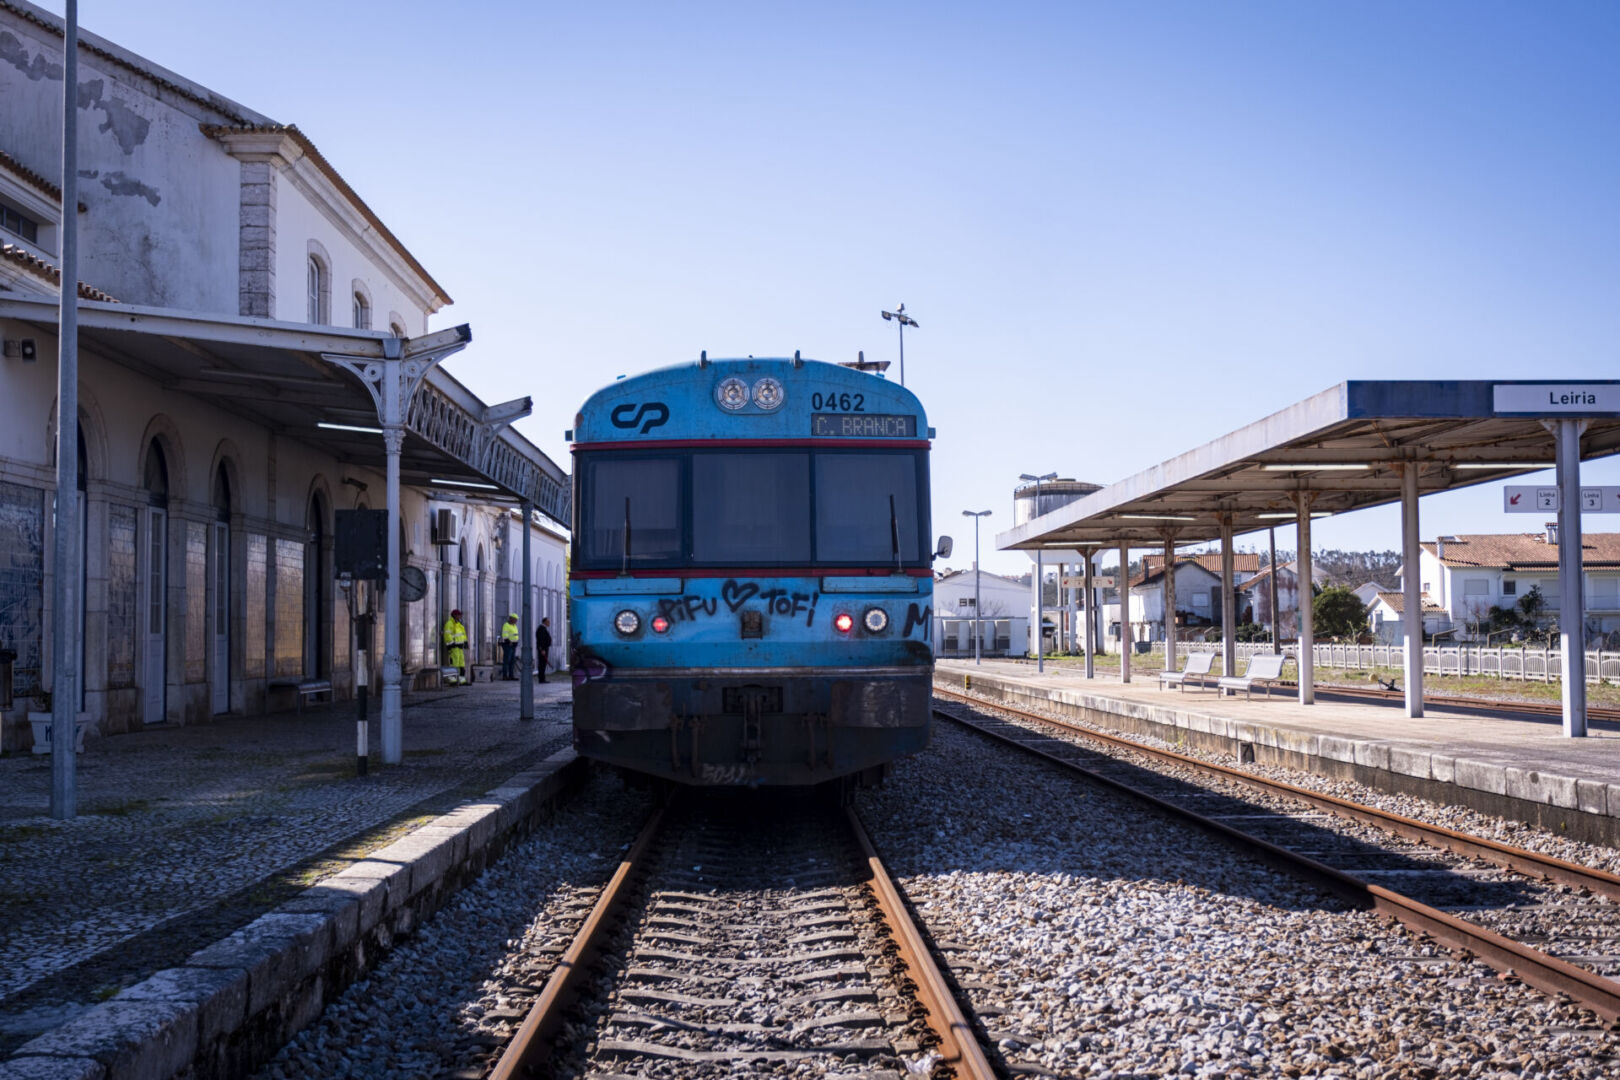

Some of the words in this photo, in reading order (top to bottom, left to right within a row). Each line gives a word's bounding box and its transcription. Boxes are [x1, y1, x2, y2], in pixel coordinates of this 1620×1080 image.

[811, 392, 865, 412] 0462
[1549, 391, 1596, 405] Leiria
[611, 402, 670, 434] CP
[842, 416, 907, 436] BRANCA
[1544, 498, 1551, 506] 2
